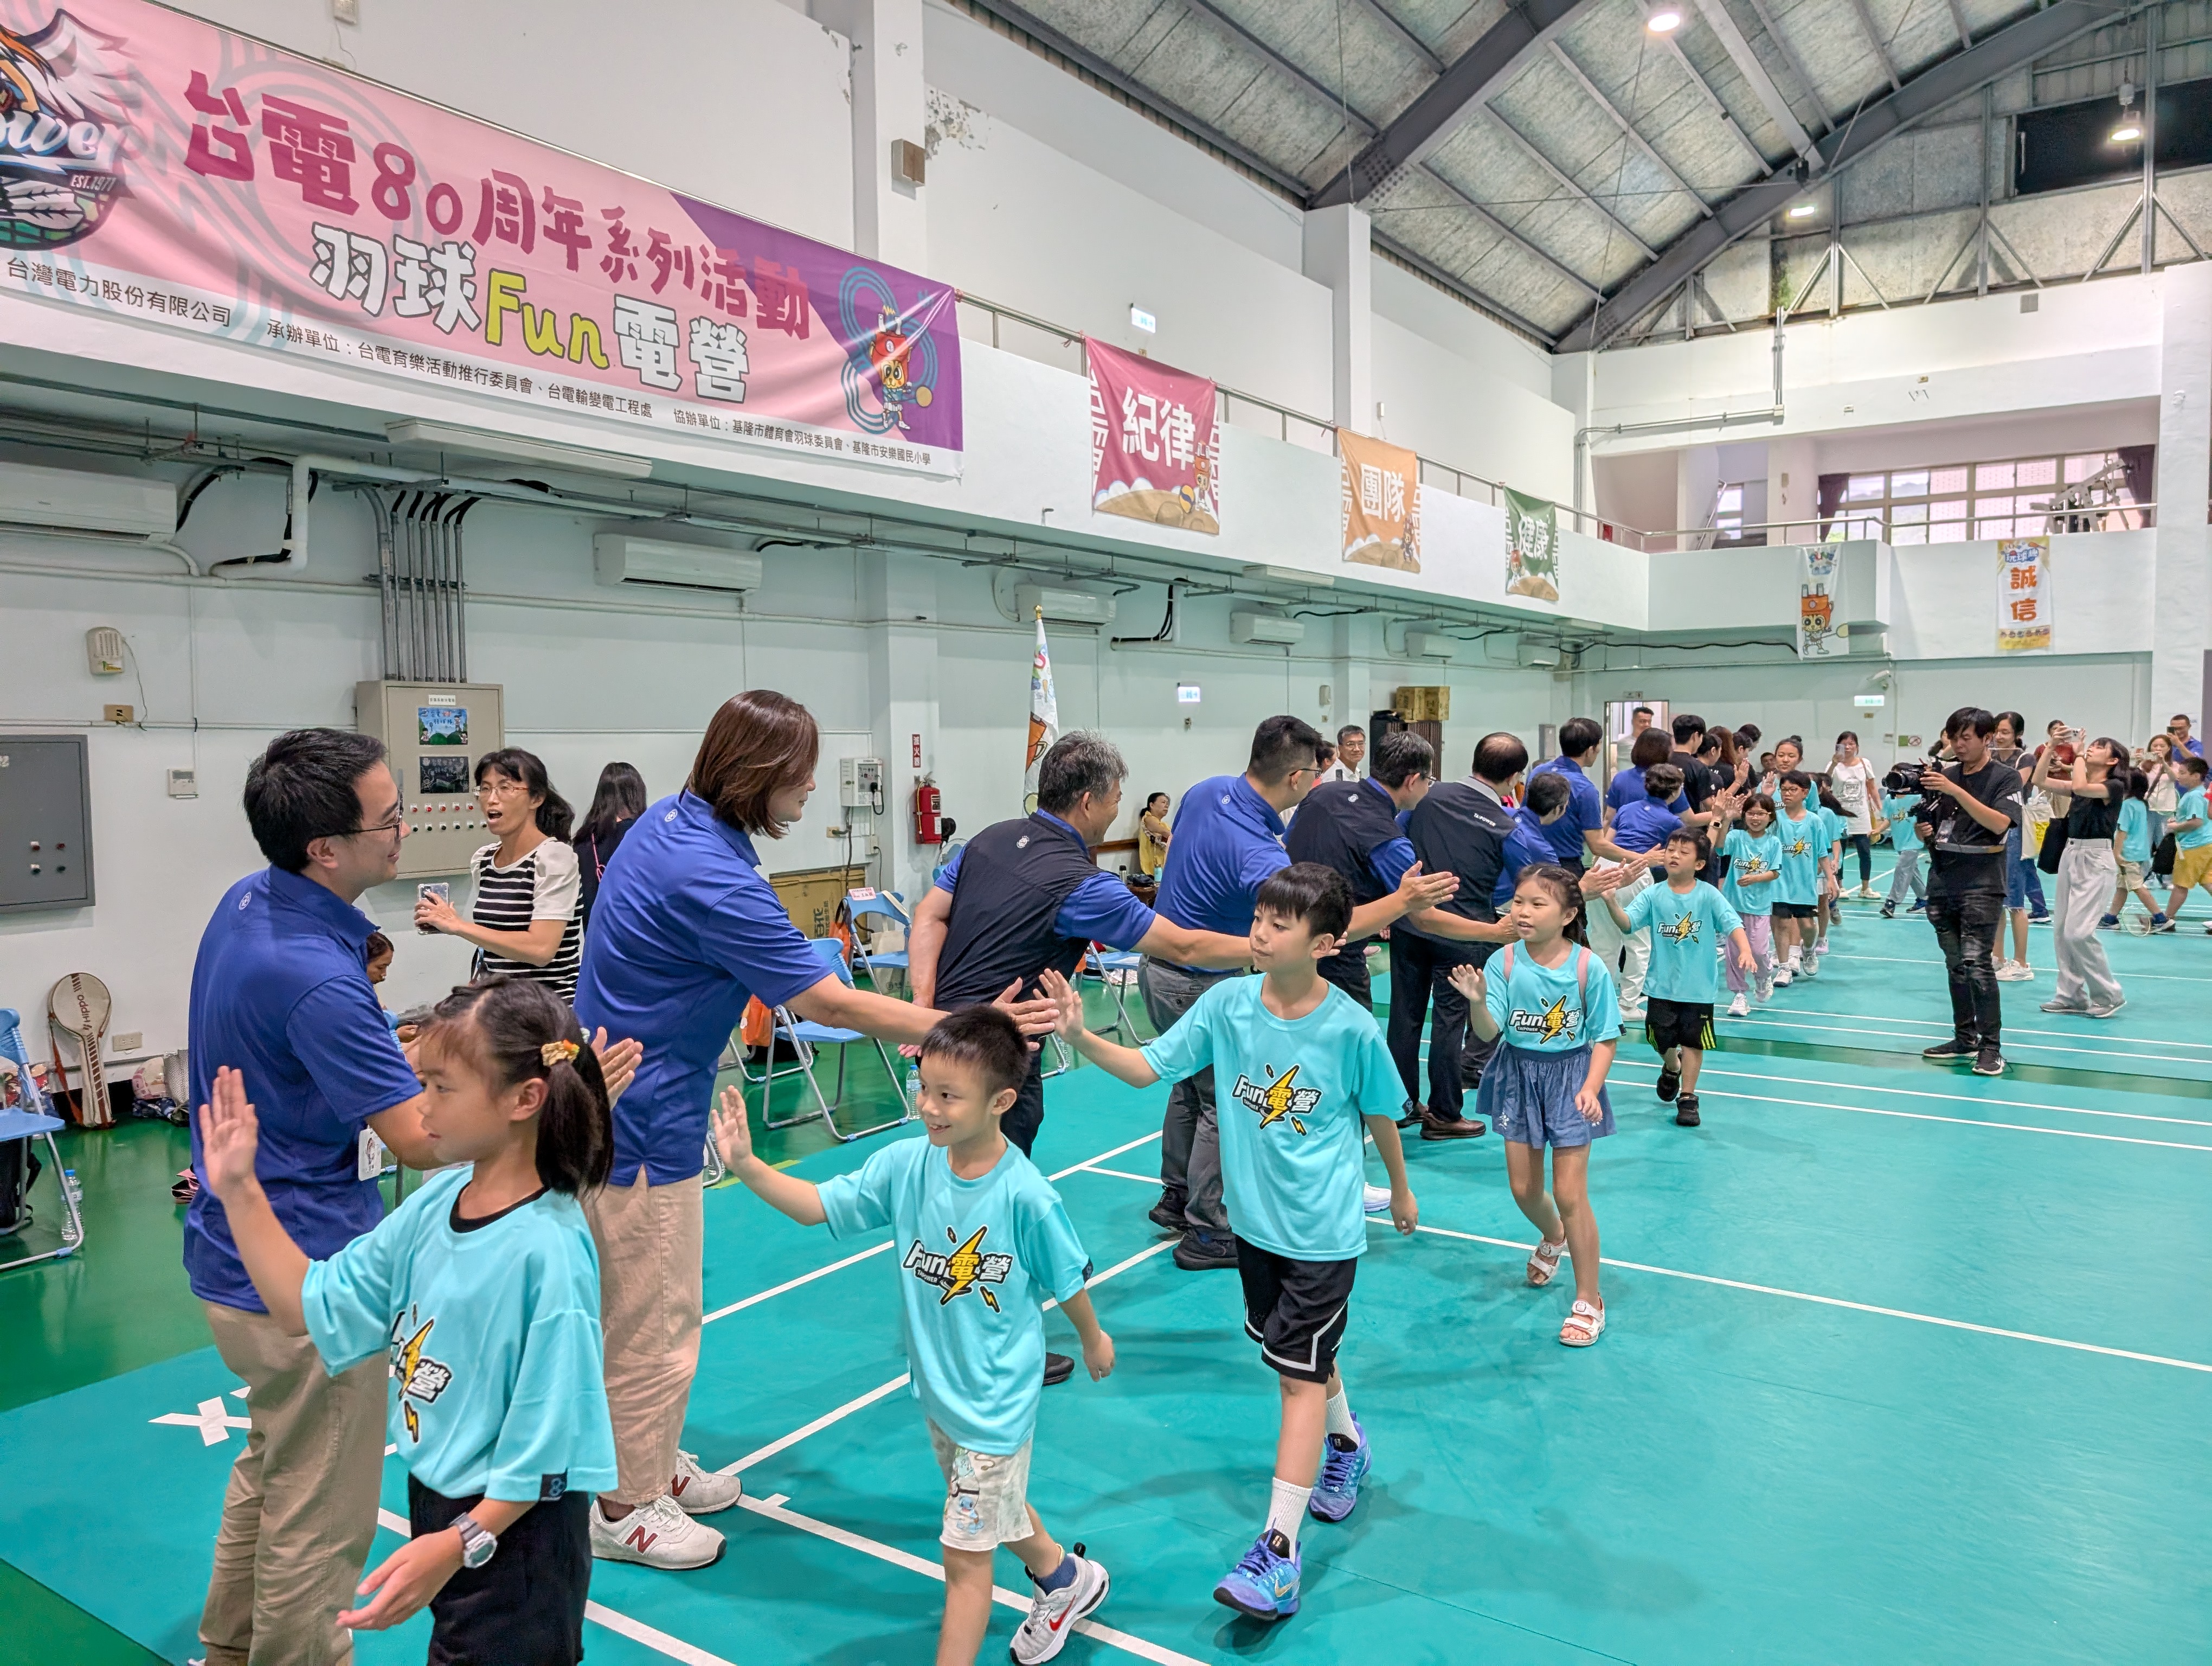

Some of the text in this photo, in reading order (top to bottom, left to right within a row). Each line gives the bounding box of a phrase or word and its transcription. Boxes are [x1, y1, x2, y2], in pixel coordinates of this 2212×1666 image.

[184, 70, 810, 341] 台電80周年系列活動
[7, 257, 231, 327] 台灣電力股份有限公司
[310, 222, 750, 403] 羽球Fun電營
[1122, 386, 1196, 471] 紀律
[1361, 463, 1406, 522] 團隊
[2010, 565, 2037, 622] 誠信
[1474, 812, 1496, 827] TAIPOWER
[77, 994, 91, 1023] Hippo
[1509, 1009, 1581, 1028] Fun電營
[1233, 1075, 1321, 1112] Fun電營
[904, 1241, 1012, 1282] Fun電營
